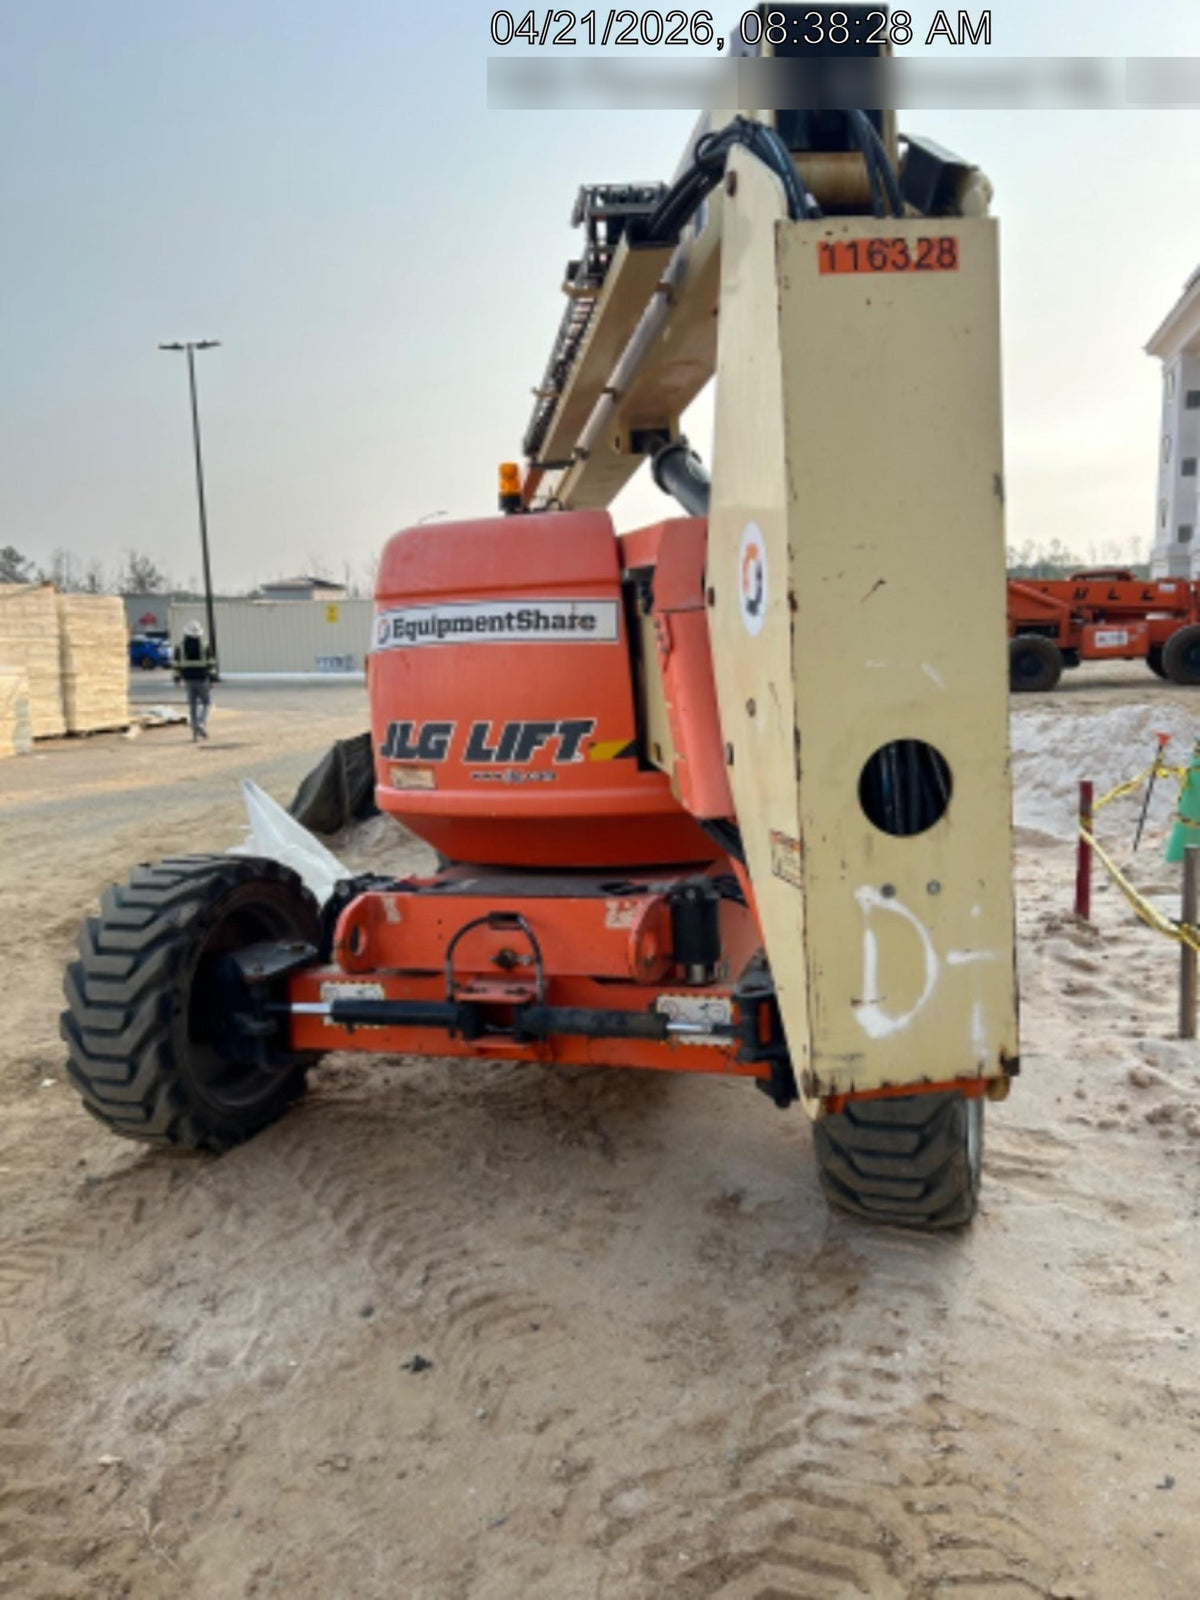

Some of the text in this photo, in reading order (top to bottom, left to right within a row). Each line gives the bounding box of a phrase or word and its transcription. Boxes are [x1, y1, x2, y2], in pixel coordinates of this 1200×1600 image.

[820, 237, 957, 271] 116328
[392, 609, 596, 642] EquipmentShare
[379, 717, 597, 765] JLG LIFT
